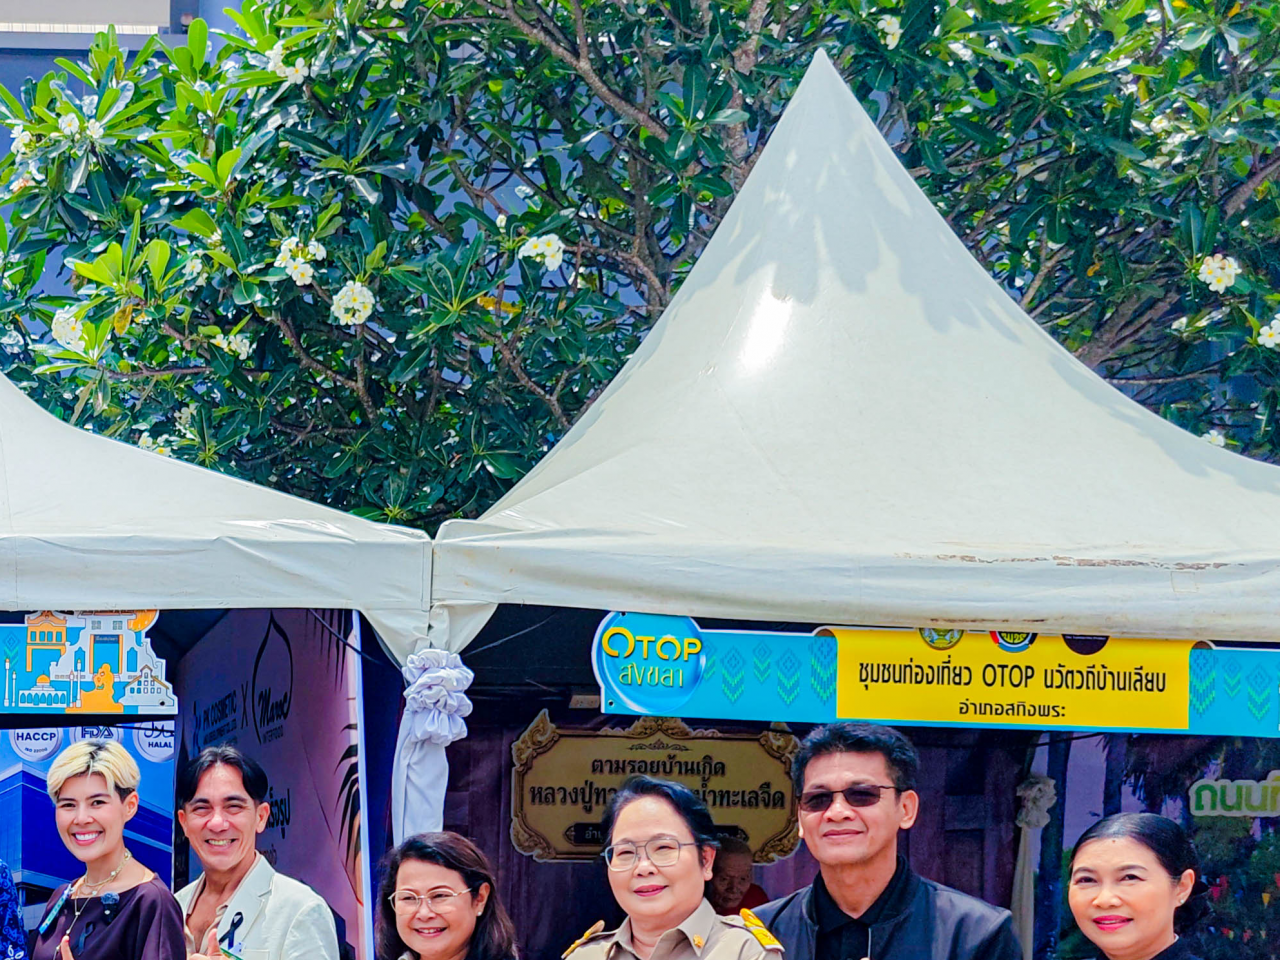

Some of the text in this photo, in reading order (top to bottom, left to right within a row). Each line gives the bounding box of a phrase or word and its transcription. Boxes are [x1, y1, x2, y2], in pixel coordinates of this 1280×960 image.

[602, 626, 702, 660] OTOP
[859, 656, 972, 690] ชุมชนท่องเที่ยว
[982, 663, 1035, 688] OTOP
[959, 698, 1066, 718] อำเภอสทิงพระ
[17, 731, 57, 742] HACCP
[81, 726, 114, 739] FDA
[148, 741, 173, 749] HALAL
